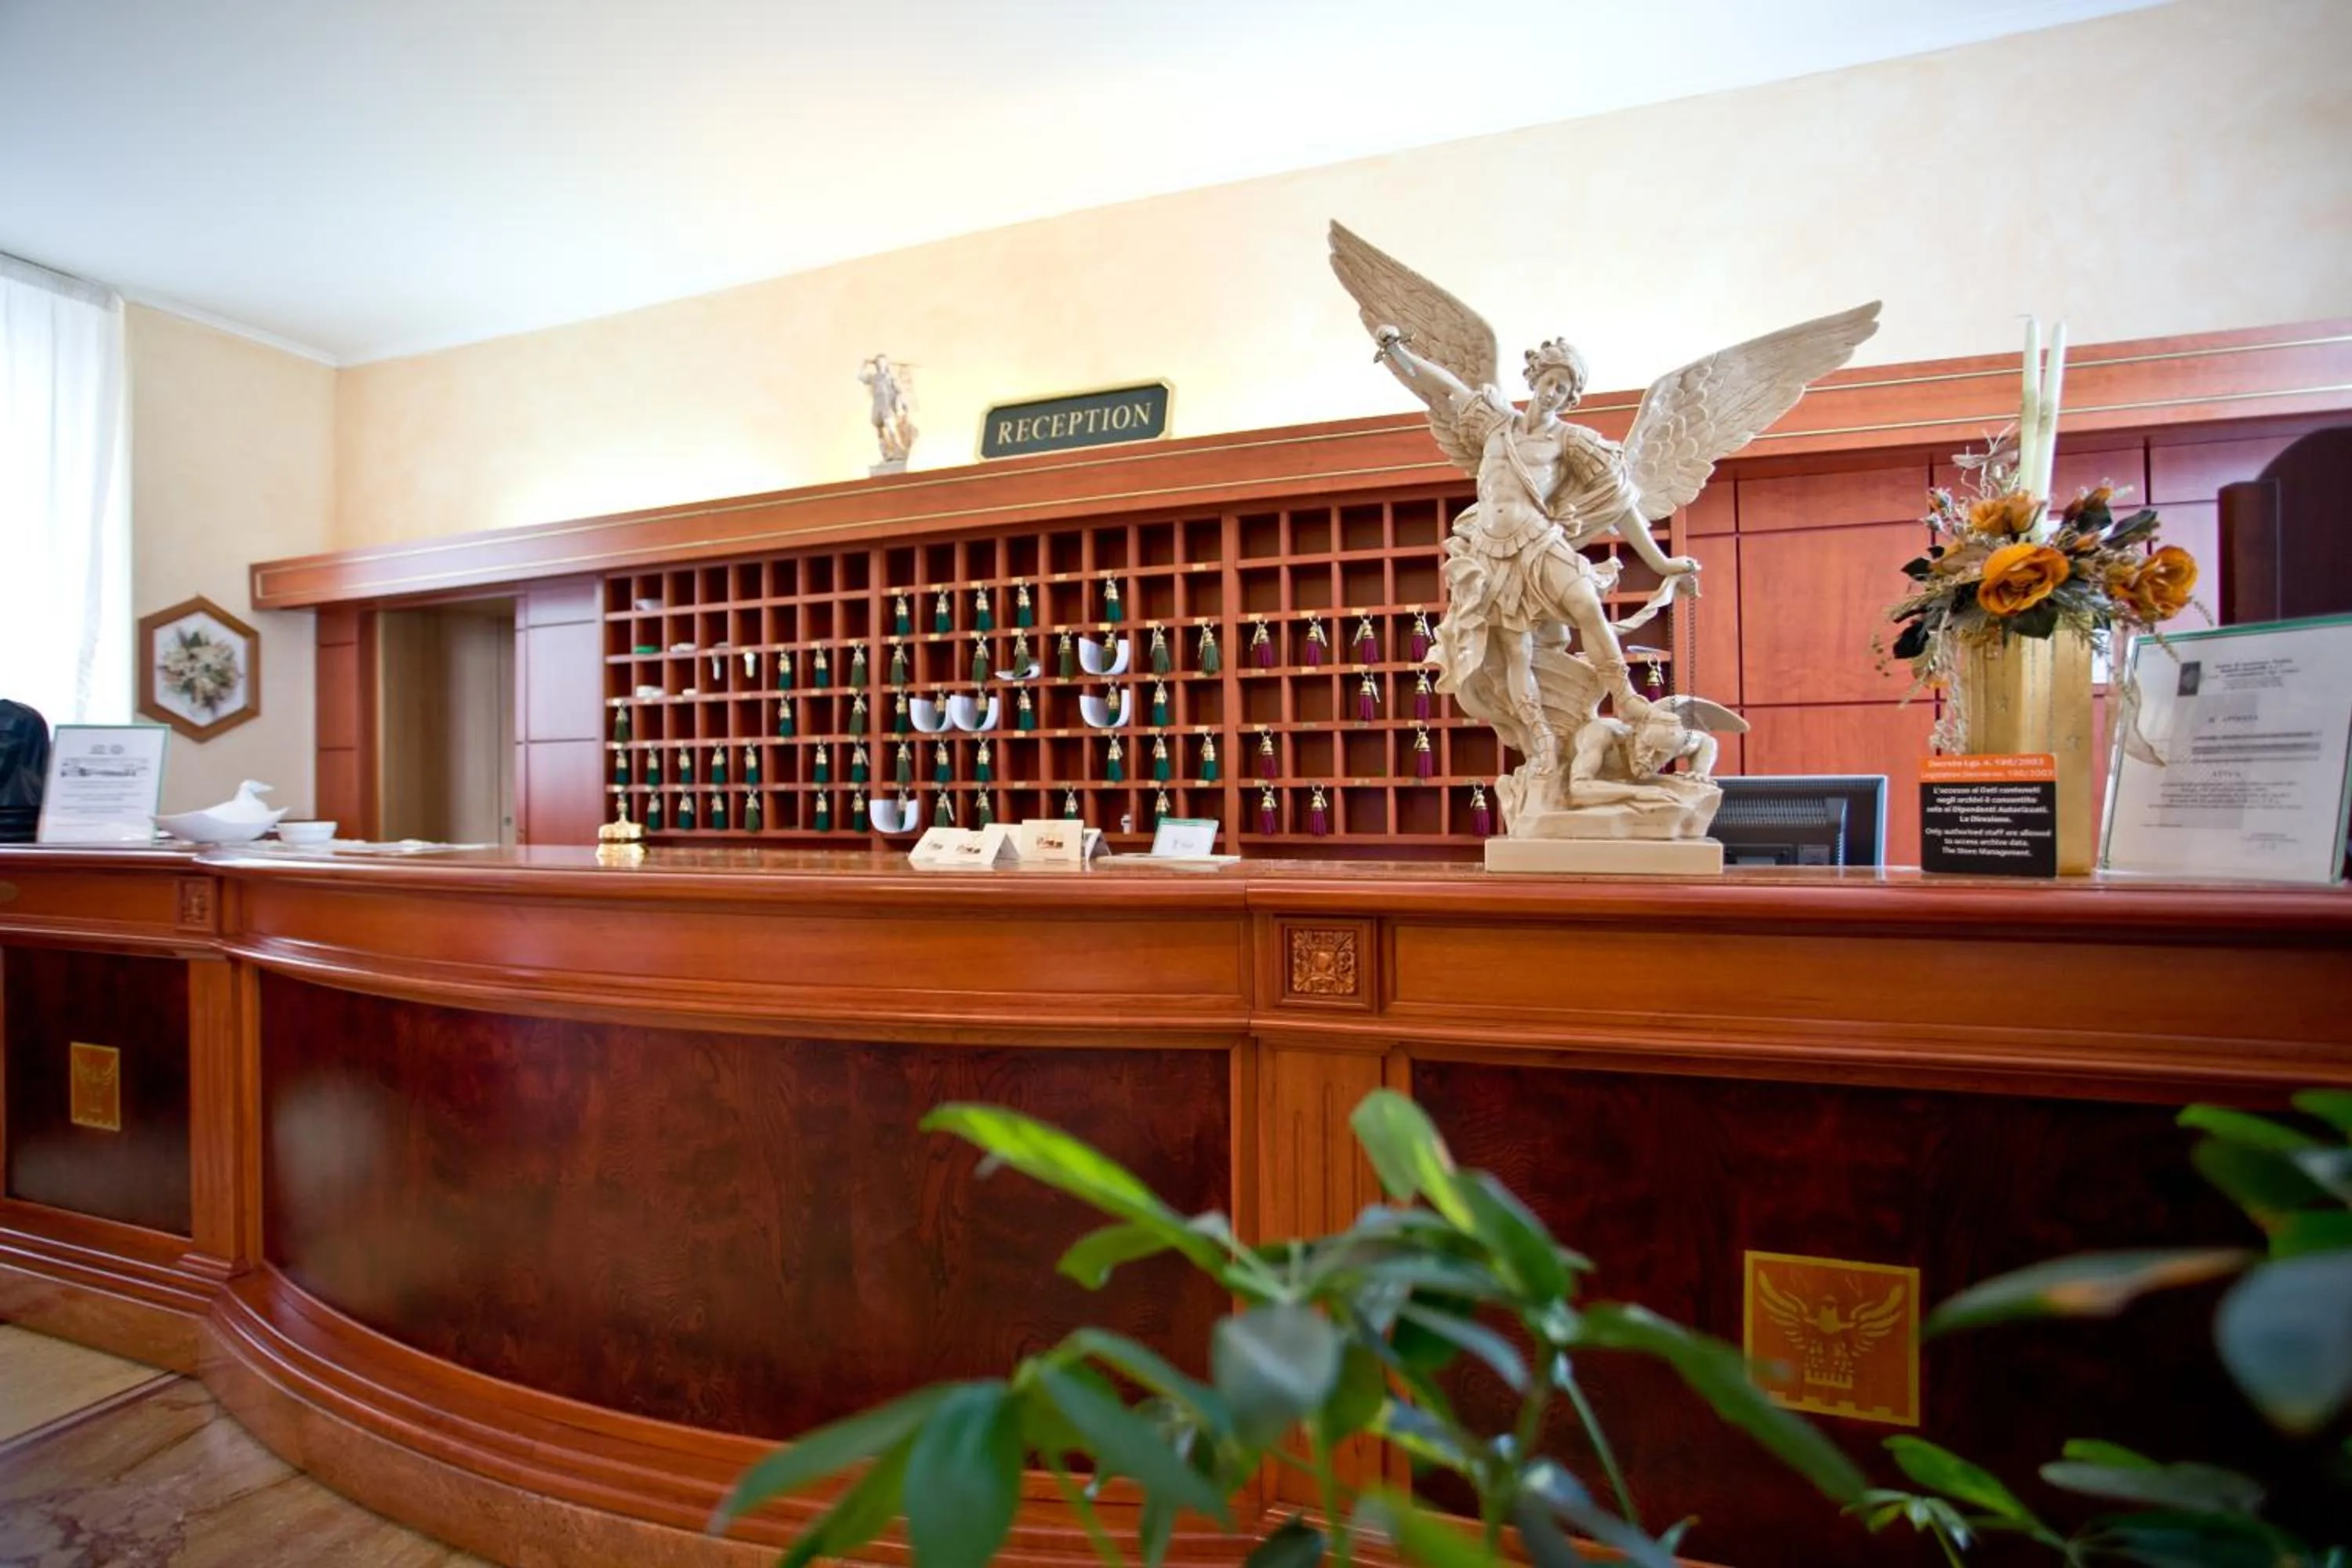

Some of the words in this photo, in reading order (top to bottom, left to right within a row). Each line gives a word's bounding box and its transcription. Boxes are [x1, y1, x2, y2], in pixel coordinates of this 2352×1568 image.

[996, 402, 1153, 445] RECEPTION
[1936, 796, 1956, 804] negli
[1952, 805, 1997, 815] Dipendenti
[1925, 827, 1943, 837] Only
[1984, 828, 2004, 837] staff
